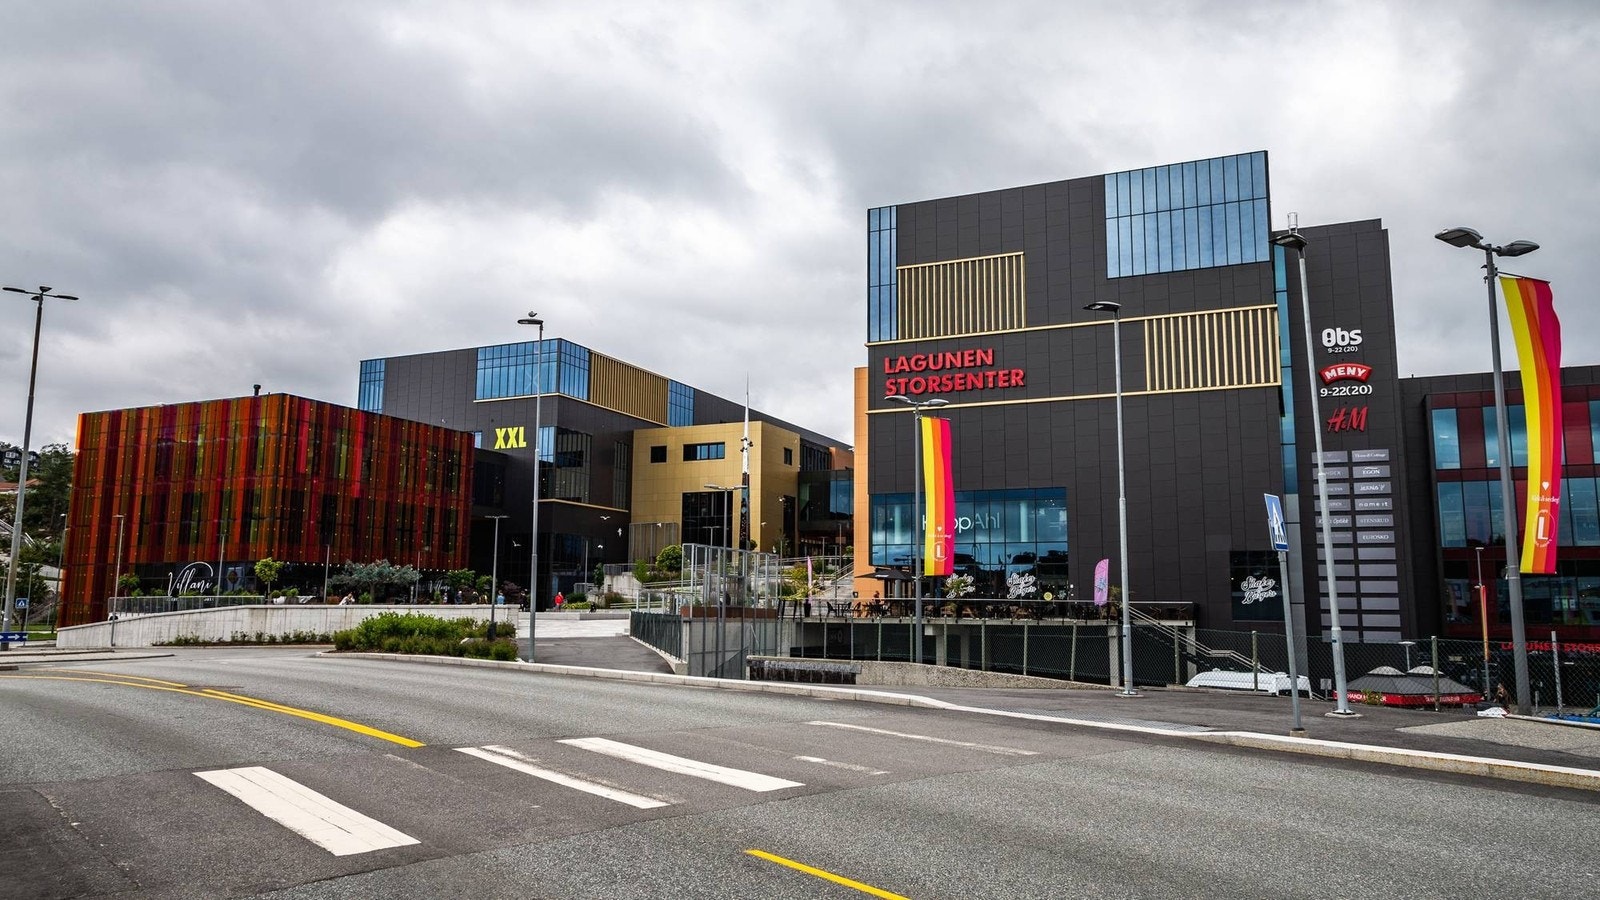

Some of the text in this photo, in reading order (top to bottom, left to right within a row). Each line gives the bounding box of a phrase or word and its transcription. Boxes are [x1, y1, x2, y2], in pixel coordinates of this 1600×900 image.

[1322, 327, 1363, 347] Obs
[884, 348, 994, 374] LAGUNEN
[885, 369, 1025, 396] STORSENTER
[1325, 367, 1366, 379] MENY
[1320, 385, 1373, 397] 9-22(20)
[1327, 405, 1368, 432] H&M
[494, 426, 527, 449] XXL
[923, 513, 1000, 533] pAhl
[168, 562, 213, 596] Villani
[1501, 642, 1560, 651] LAUNEN
